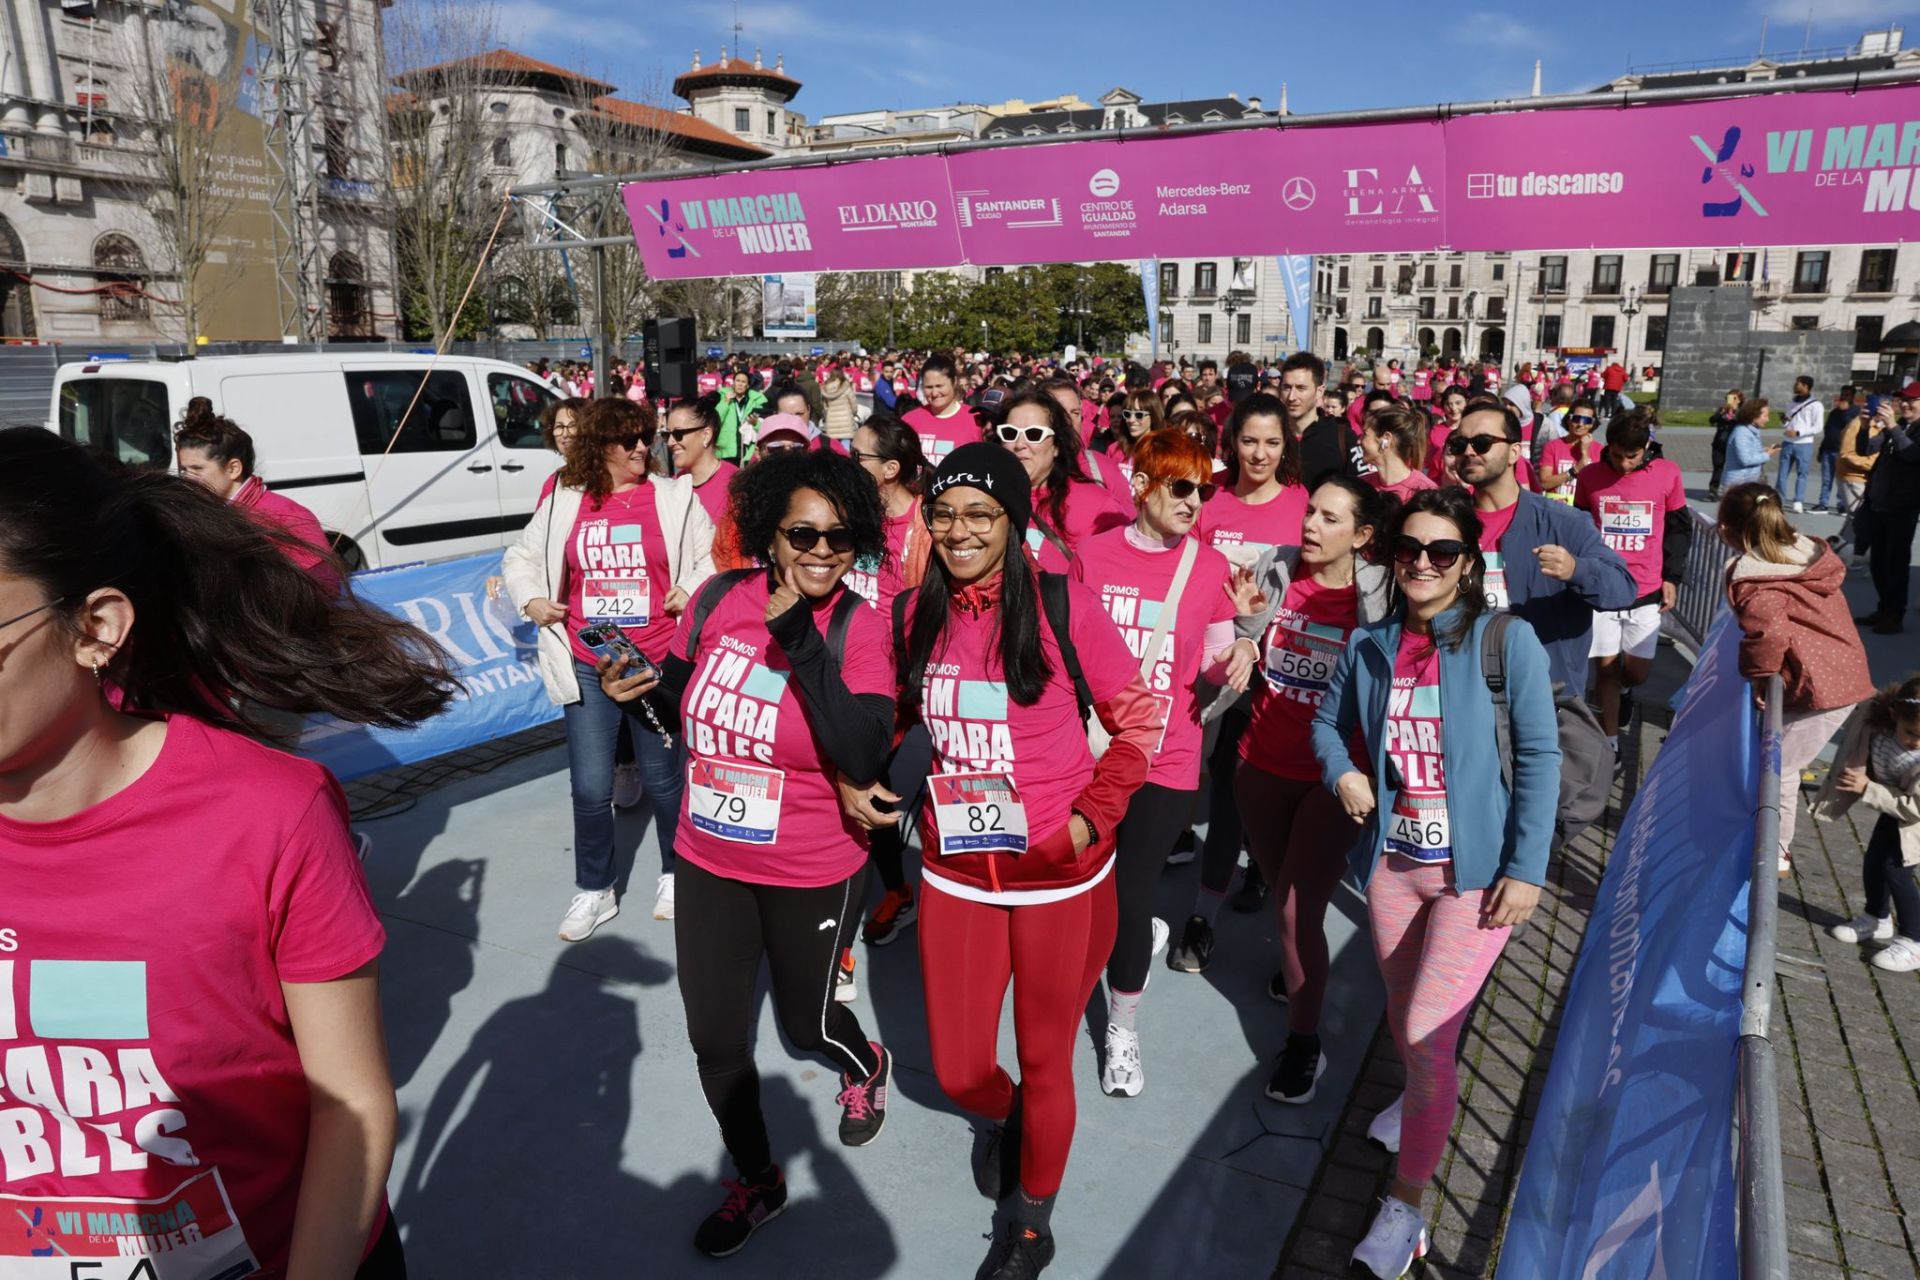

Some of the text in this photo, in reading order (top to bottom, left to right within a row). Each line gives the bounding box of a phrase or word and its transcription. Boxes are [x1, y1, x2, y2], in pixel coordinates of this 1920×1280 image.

[1766, 129, 1813, 174] VI
[1497, 171, 1624, 197] tu descanso
[1815, 172, 1839, 187] DE
[1842, 171, 1864, 185] LA
[1156, 182, 1251, 199] Mercedes-Benz
[1343, 188, 1384, 197] ELENA
[680, 192, 806, 229] VI MARCHA
[838, 200, 937, 225] EL DIARIO
[975, 199, 1045, 212] SANTANDER
[976, 211, 1002, 220] CIUDAD
[1080, 200, 1134, 213] CENTRO DE
[1159, 203, 1207, 216] Adarsa
[1082, 211, 1136, 223] IGUALDAD
[1129, 221, 1136, 229] DE
[713, 223, 812, 255] DE LA MUJER
[1094, 230, 1130, 238] SANTANDER
[931, 472, 981, 495] Here
[1612, 515, 1641, 527] 445
[1214, 529, 1243, 539] SOMOS
[586, 544, 646, 568] PARA
[1103, 584, 1139, 596] SOMOS
[596, 598, 634, 615] 242
[1276, 607, 1310, 620] SOMOS
[720, 635, 757, 657] SOMOS
[925, 663, 960, 676] SOMOS
[1281, 653, 1328, 680] 569
[1392, 677, 1417, 687] MOS
[697, 685, 779, 743] PARA
[934, 719, 1015, 760] PARA
[1386, 719, 1443, 753] PAR
[1392, 754, 1444, 788] LE
[734, 783, 767, 800] MUJER
[713, 792, 746, 823] 79
[968, 804, 1005, 832] 82
[1396, 817, 1443, 845] 456
[0, 1044, 181, 1118] ARA
[0, 1107, 200, 1182] BLES
[56, 1199, 197, 1236] VI MARCHA
[89, 1222, 203, 1256] DE LA MUJER
